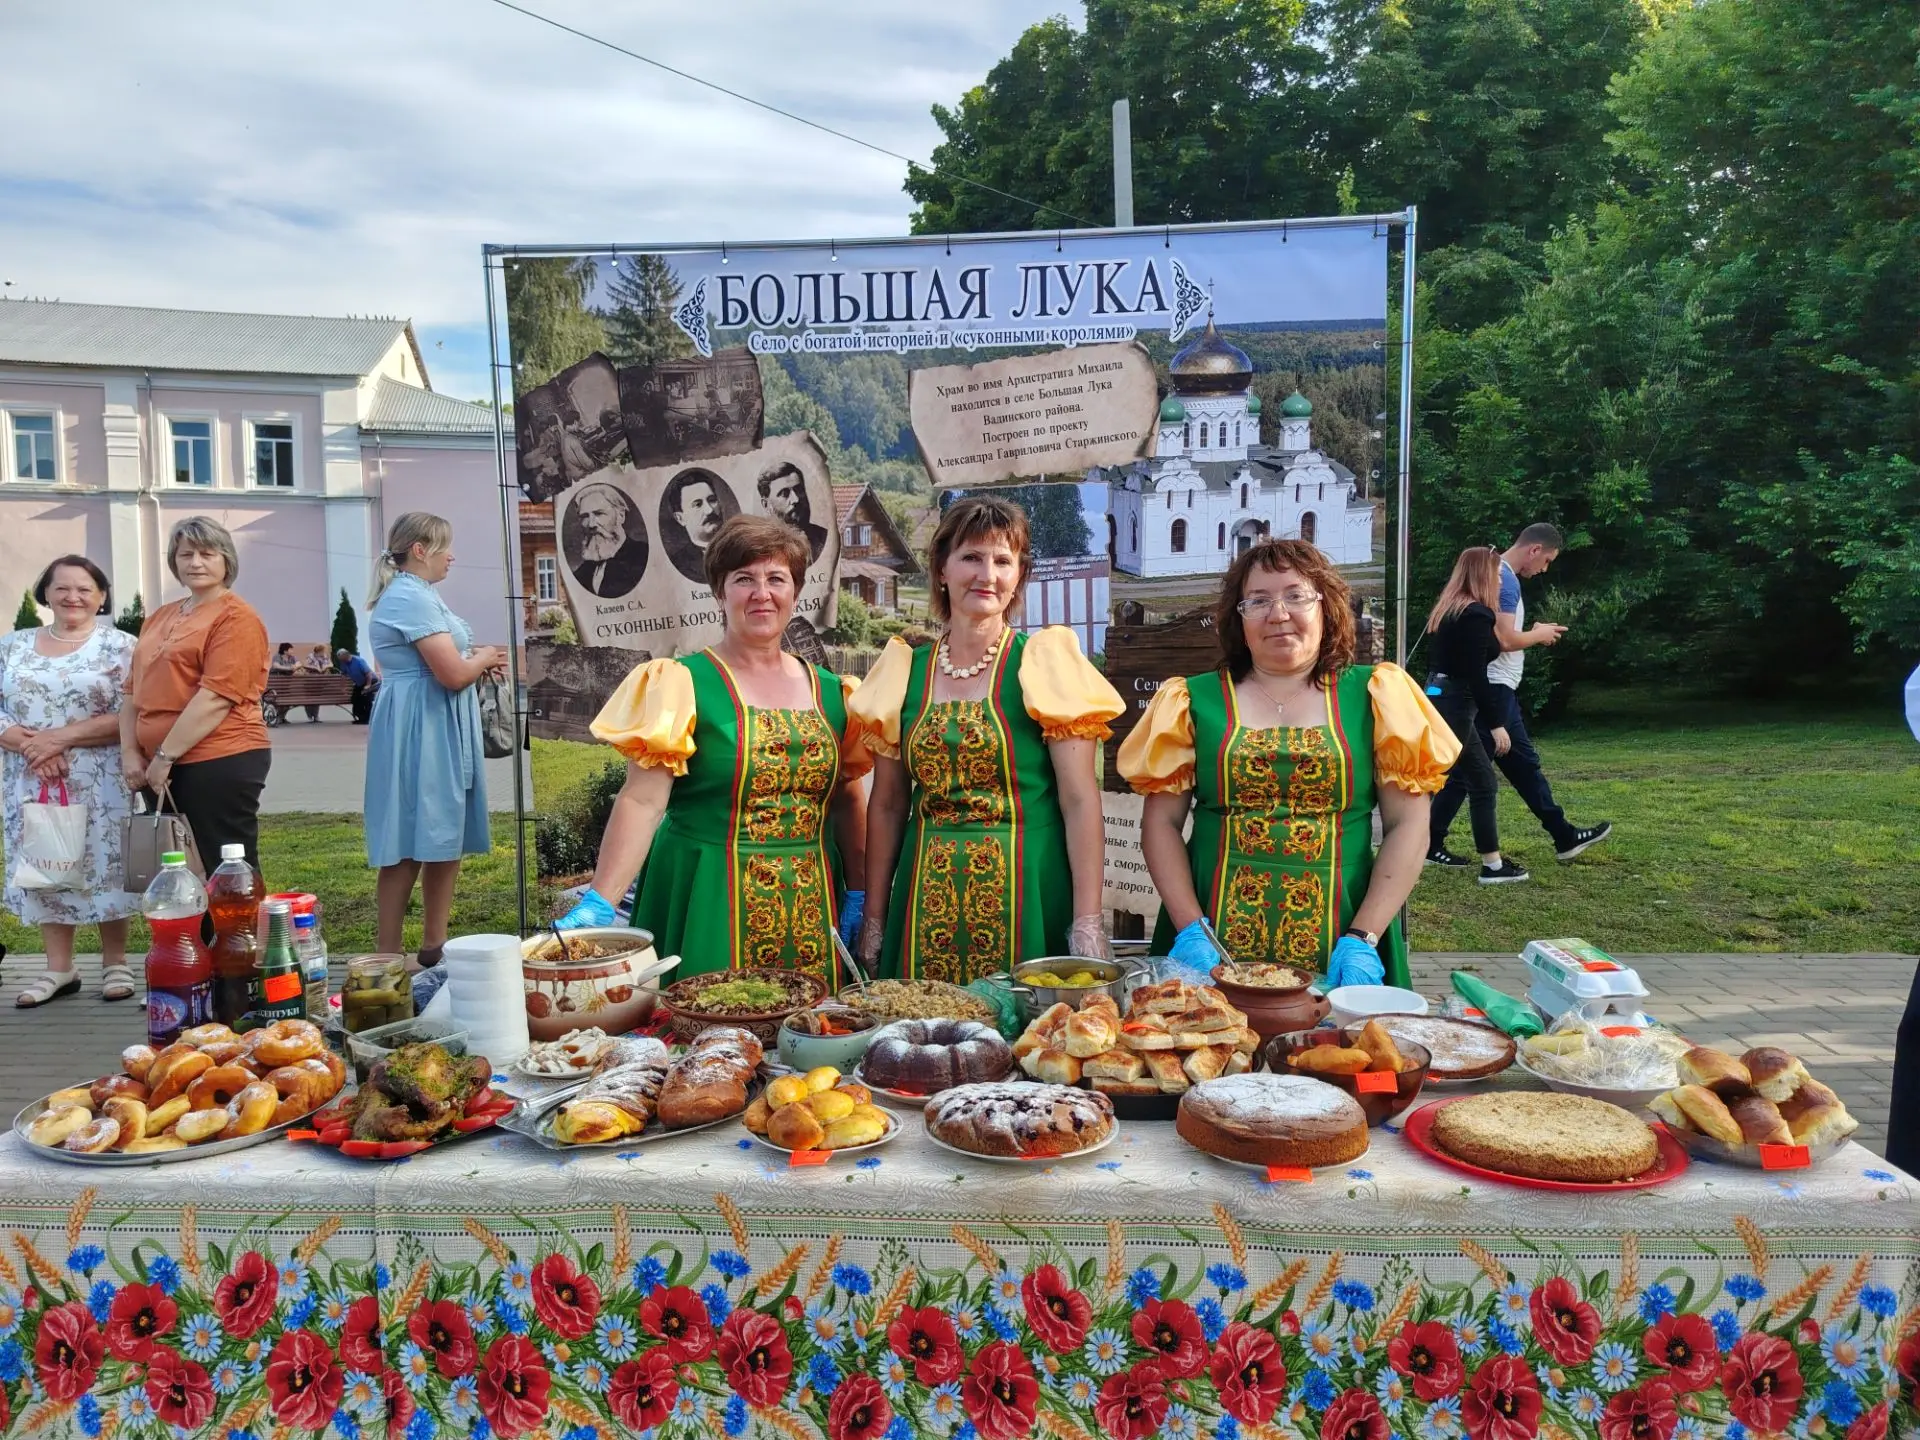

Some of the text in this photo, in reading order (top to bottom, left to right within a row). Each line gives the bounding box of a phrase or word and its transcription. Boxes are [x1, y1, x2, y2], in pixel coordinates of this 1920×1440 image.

[716, 259, 1170, 327] БОЛЬШАЯ ЛУКА
[751, 325, 1134, 352] Село с богатой историей и «суконными королями»
[936, 361, 1123, 398] Храм во имя Архистратига Михаила
[951, 379, 1113, 413] находится в селе Большая Лука
[983, 403, 1084, 426] Вадинского района.
[982, 420, 1089, 443] Построен по проекту
[937, 430, 1140, 468] Александра Гавриловича Старжинского.
[596, 604, 625, 615] Казеев
[596, 615, 676, 638] СУКОННЫЕ
[1116, 880, 1154, 895] дорога
